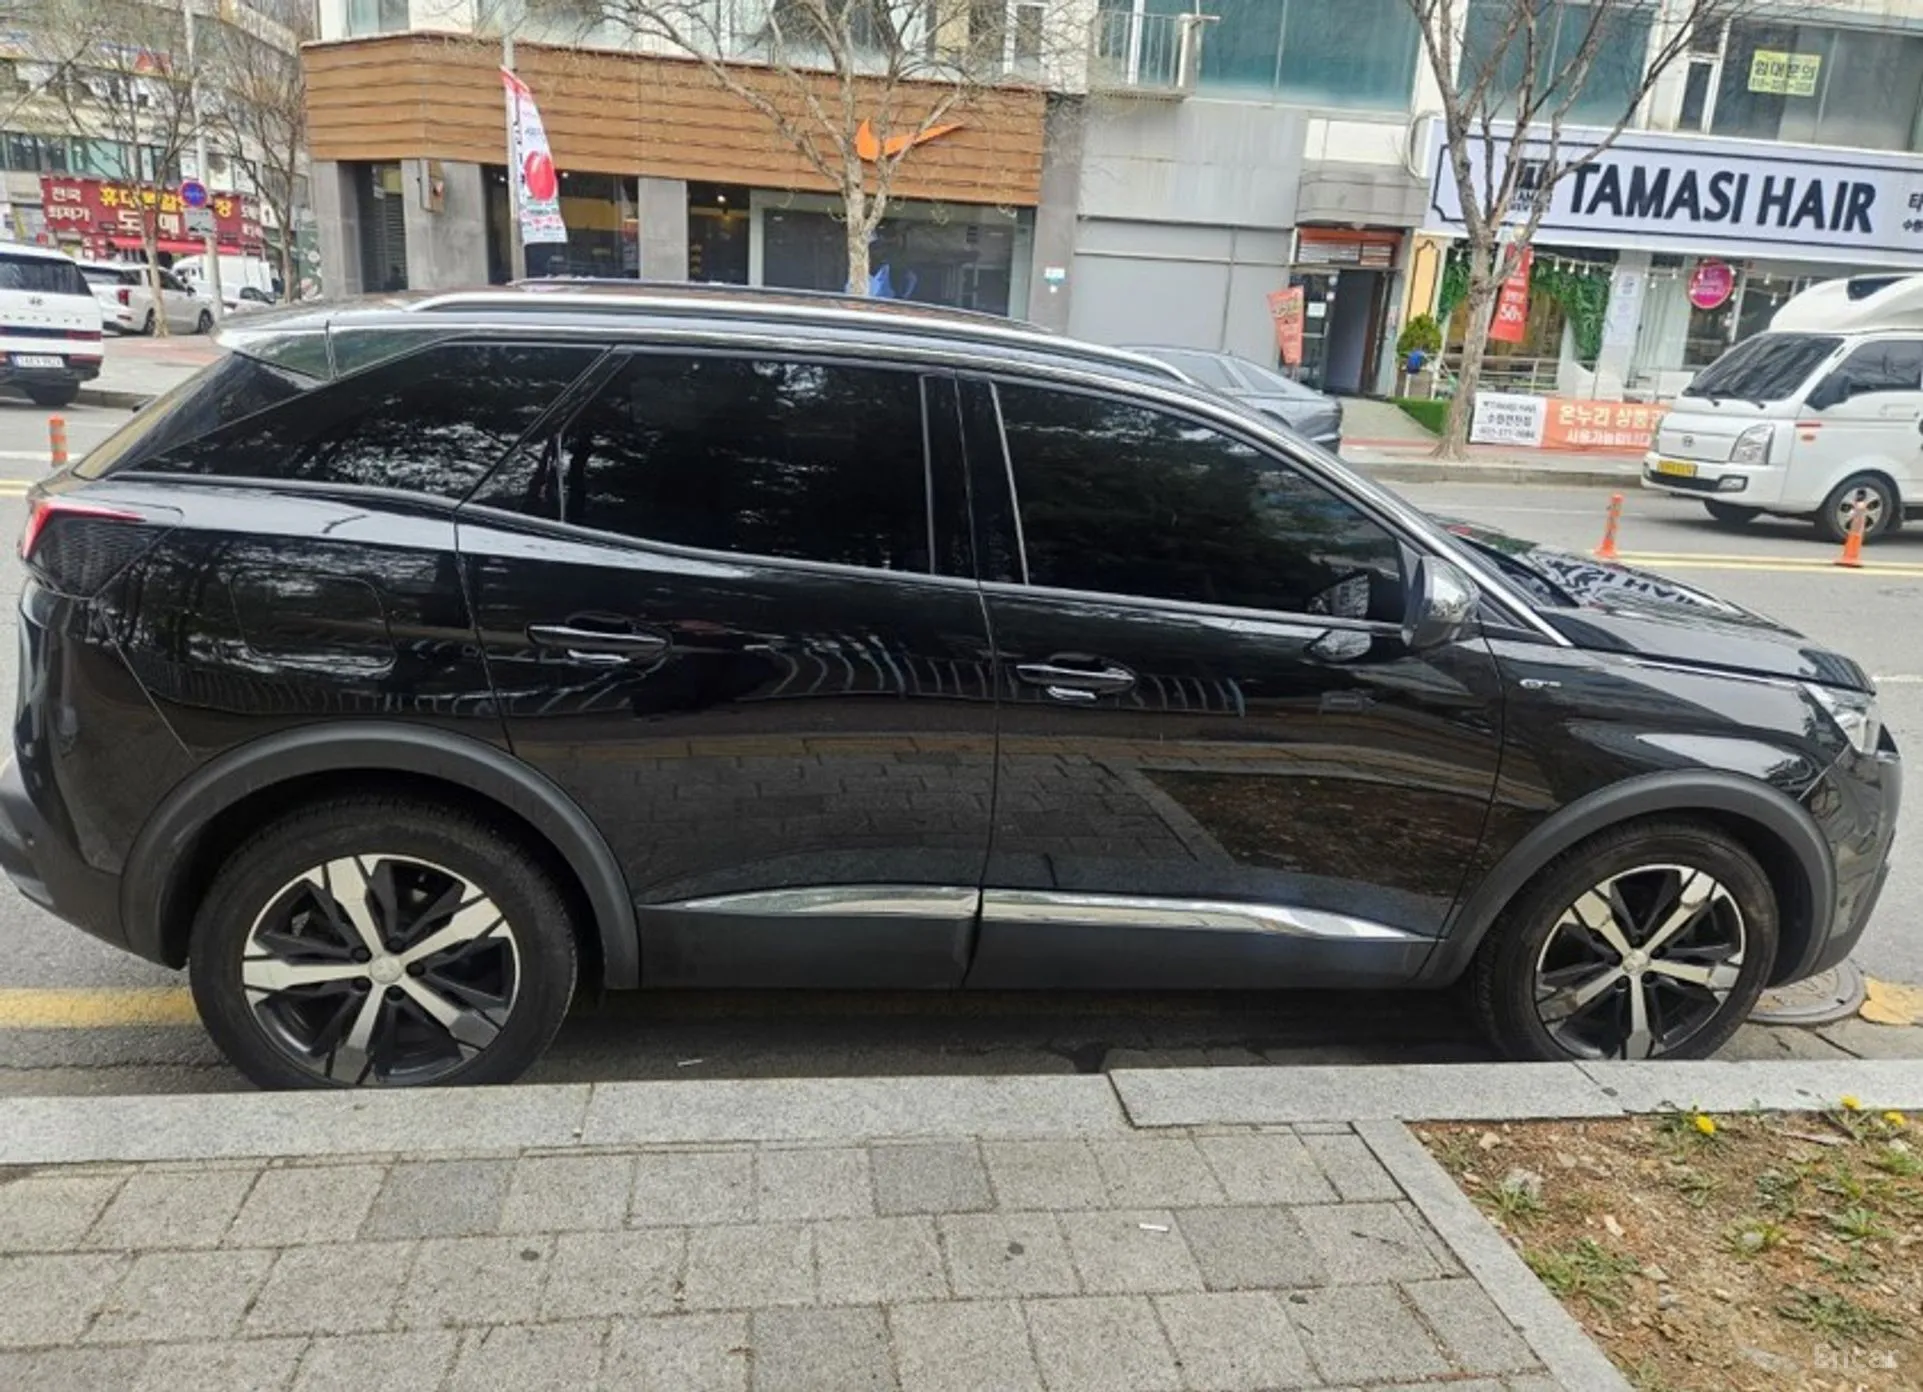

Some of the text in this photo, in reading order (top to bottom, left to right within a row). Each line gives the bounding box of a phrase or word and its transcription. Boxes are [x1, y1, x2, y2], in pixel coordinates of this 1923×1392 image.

[1566, 161, 1876, 234] TAMASI HAIR
[1558, 404, 1610, 427] 온누리
